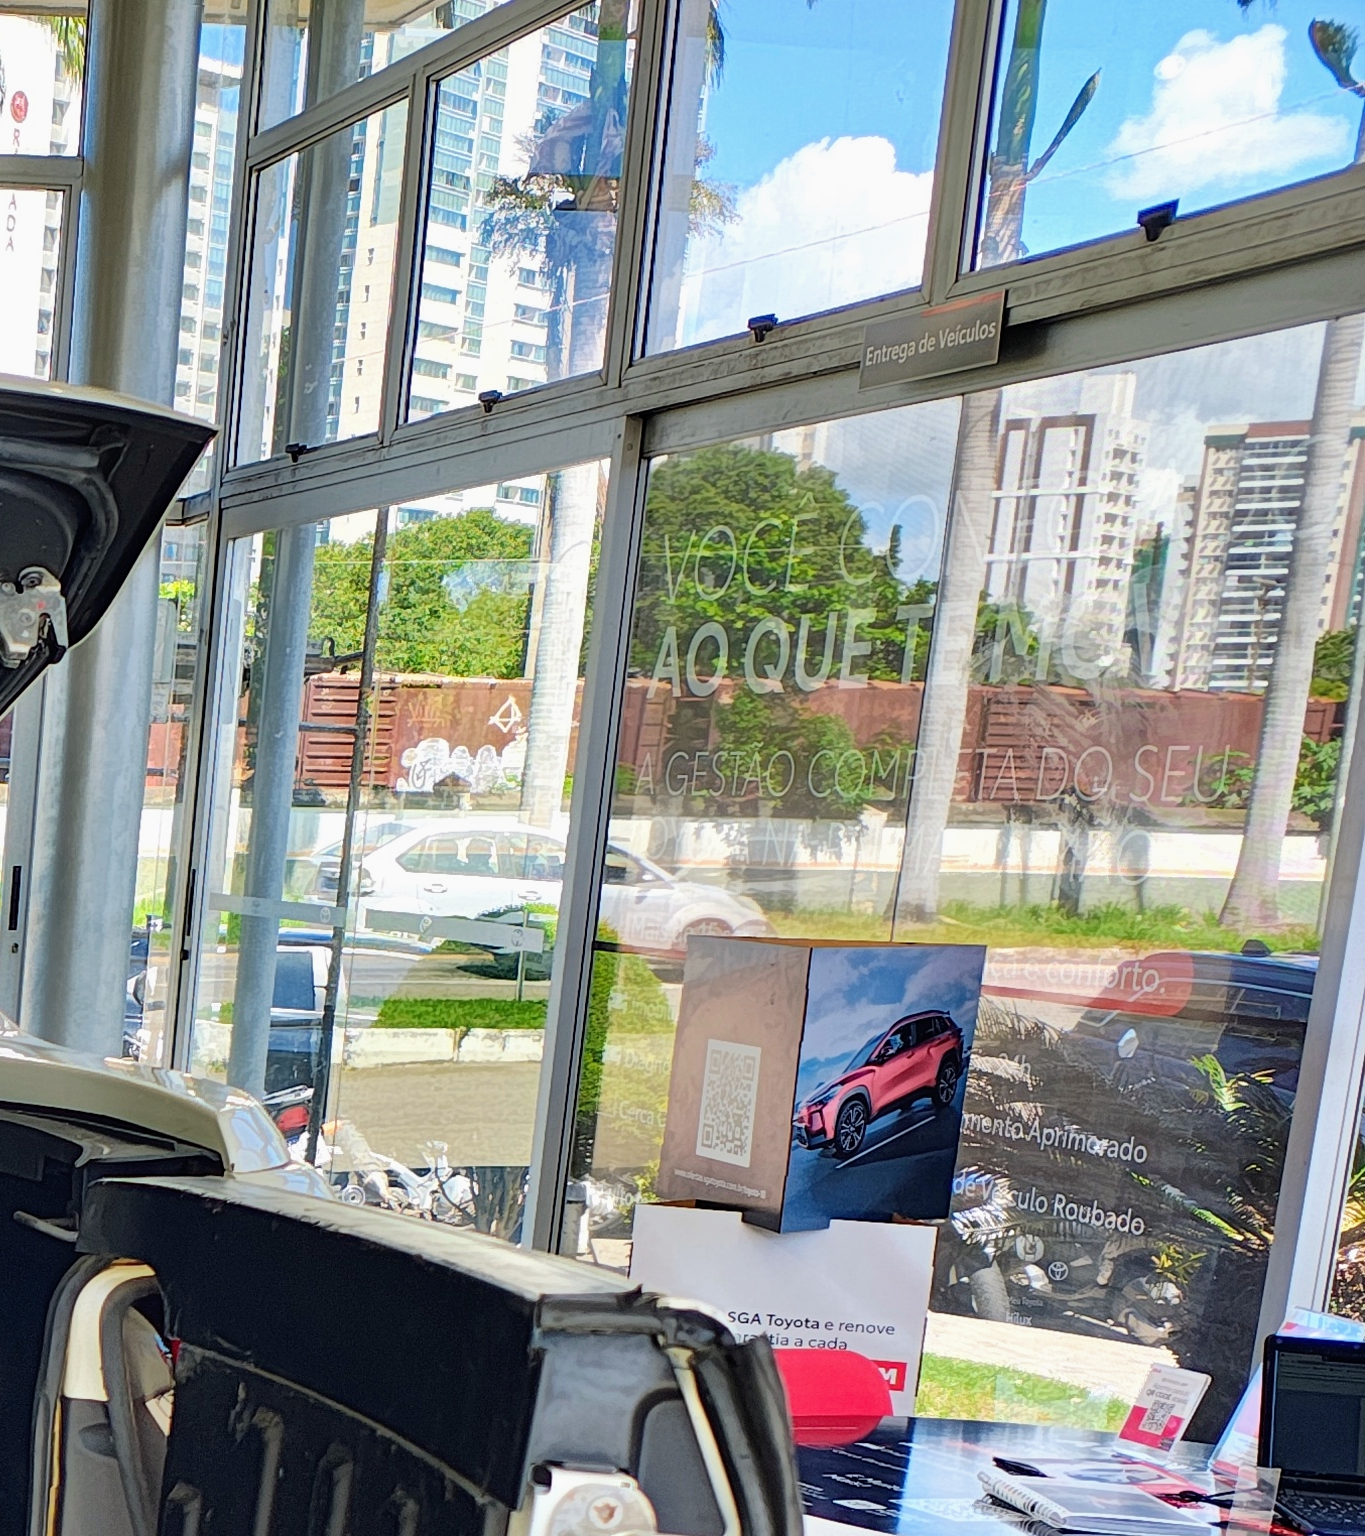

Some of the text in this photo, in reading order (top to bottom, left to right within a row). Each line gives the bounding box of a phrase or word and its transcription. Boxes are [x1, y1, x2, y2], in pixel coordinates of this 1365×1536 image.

[865, 319, 997, 367] Entrega de Veículos
[664, 491, 820, 604] VOCÊ
[647, 621, 730, 699] AO
[744, 607, 878, 695] QUE
[634, 741, 1233, 804] A GESTÃO COMPLETA DO SEU
[1045, 956, 1167, 995] conforto.
[1026, 1117, 1148, 1164] Aprimorado
[953, 1174, 976, 1196] de
[1053, 1193, 1145, 1237] Roubado
[727, 1311, 896, 1336] SGA Toyota e renove
[1006, 1311, 1033, 1327] Hilux
[794, 1337, 804, 1348] a
[808, 1337, 849, 1351] cada
